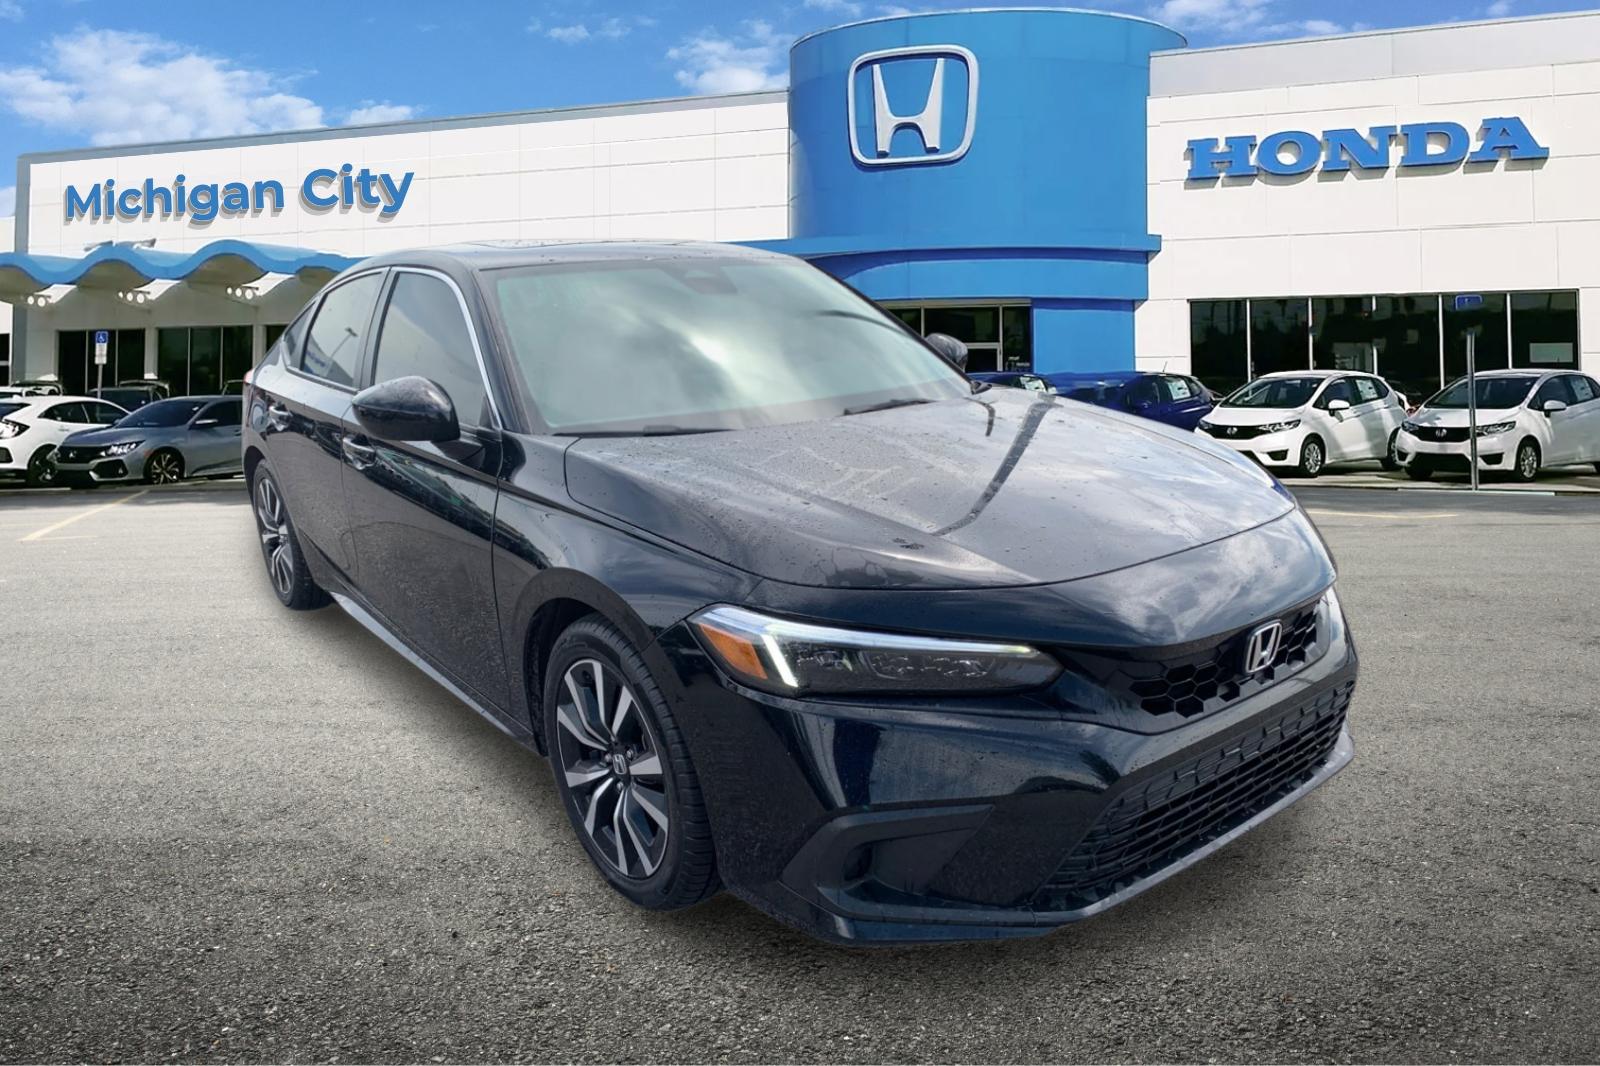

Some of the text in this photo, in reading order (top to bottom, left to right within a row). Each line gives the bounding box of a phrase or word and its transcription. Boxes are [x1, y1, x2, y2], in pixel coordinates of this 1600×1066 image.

[1186, 116, 1550, 182] HONDA
[65, 163, 415, 223] Michigan City
